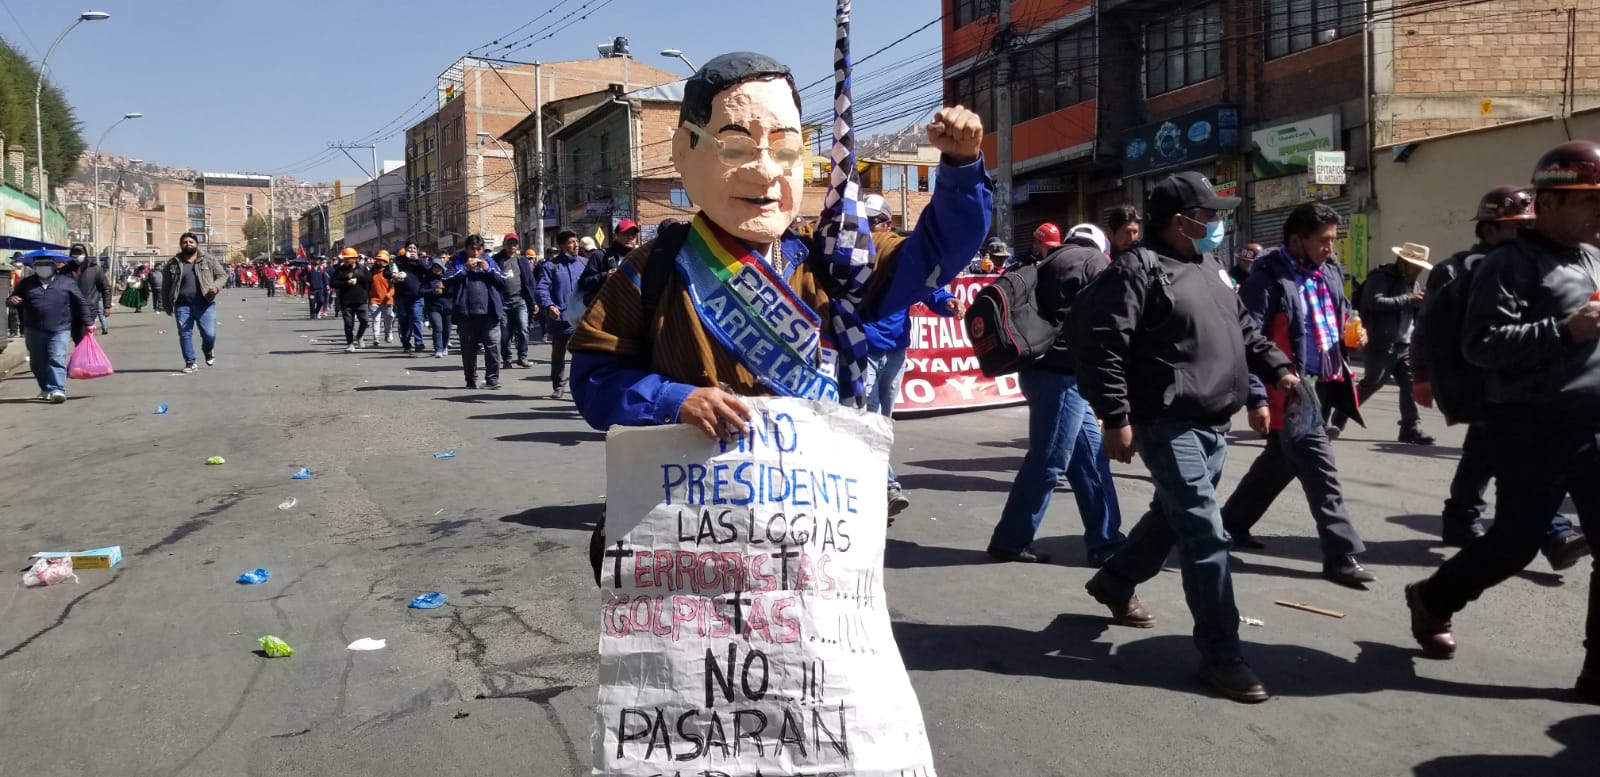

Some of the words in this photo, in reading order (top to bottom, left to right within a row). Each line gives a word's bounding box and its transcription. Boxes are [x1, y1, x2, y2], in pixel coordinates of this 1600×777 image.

[703, 295, 774, 367] ARCE
[662, 463, 858, 514] PRESIDENTE
[678, 510, 738, 545] LAS
[750, 512, 851, 553] LOGIAS
[616, 699, 850, 761] PASARAN
